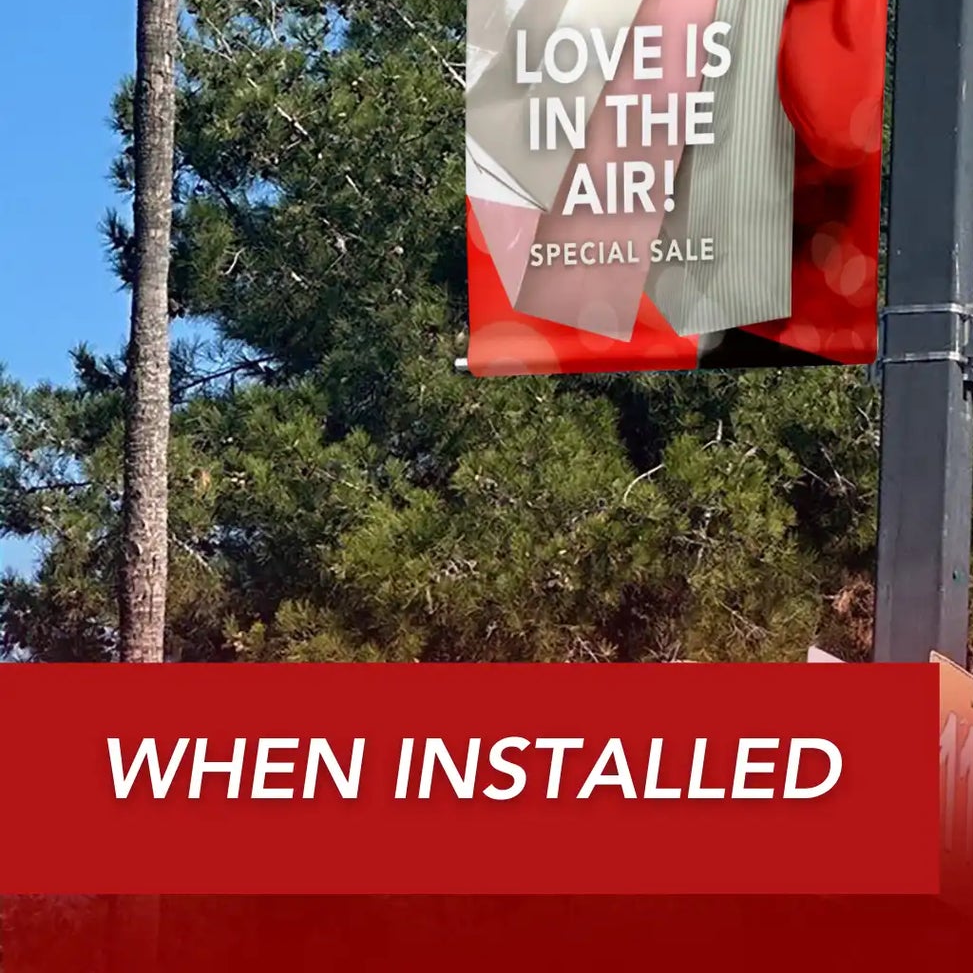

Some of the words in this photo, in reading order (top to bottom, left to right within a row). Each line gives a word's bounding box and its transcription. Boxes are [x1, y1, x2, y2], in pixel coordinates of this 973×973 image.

[515, 25, 664, 84] LOVE
[685, 20, 733, 79] IS
[529, 95, 586, 151] IN
[605, 91, 716, 149] THE
[561, 159, 676, 216] AIR!
[529, 239, 640, 267] SPECIAL
[649, 237, 715, 263] SALE
